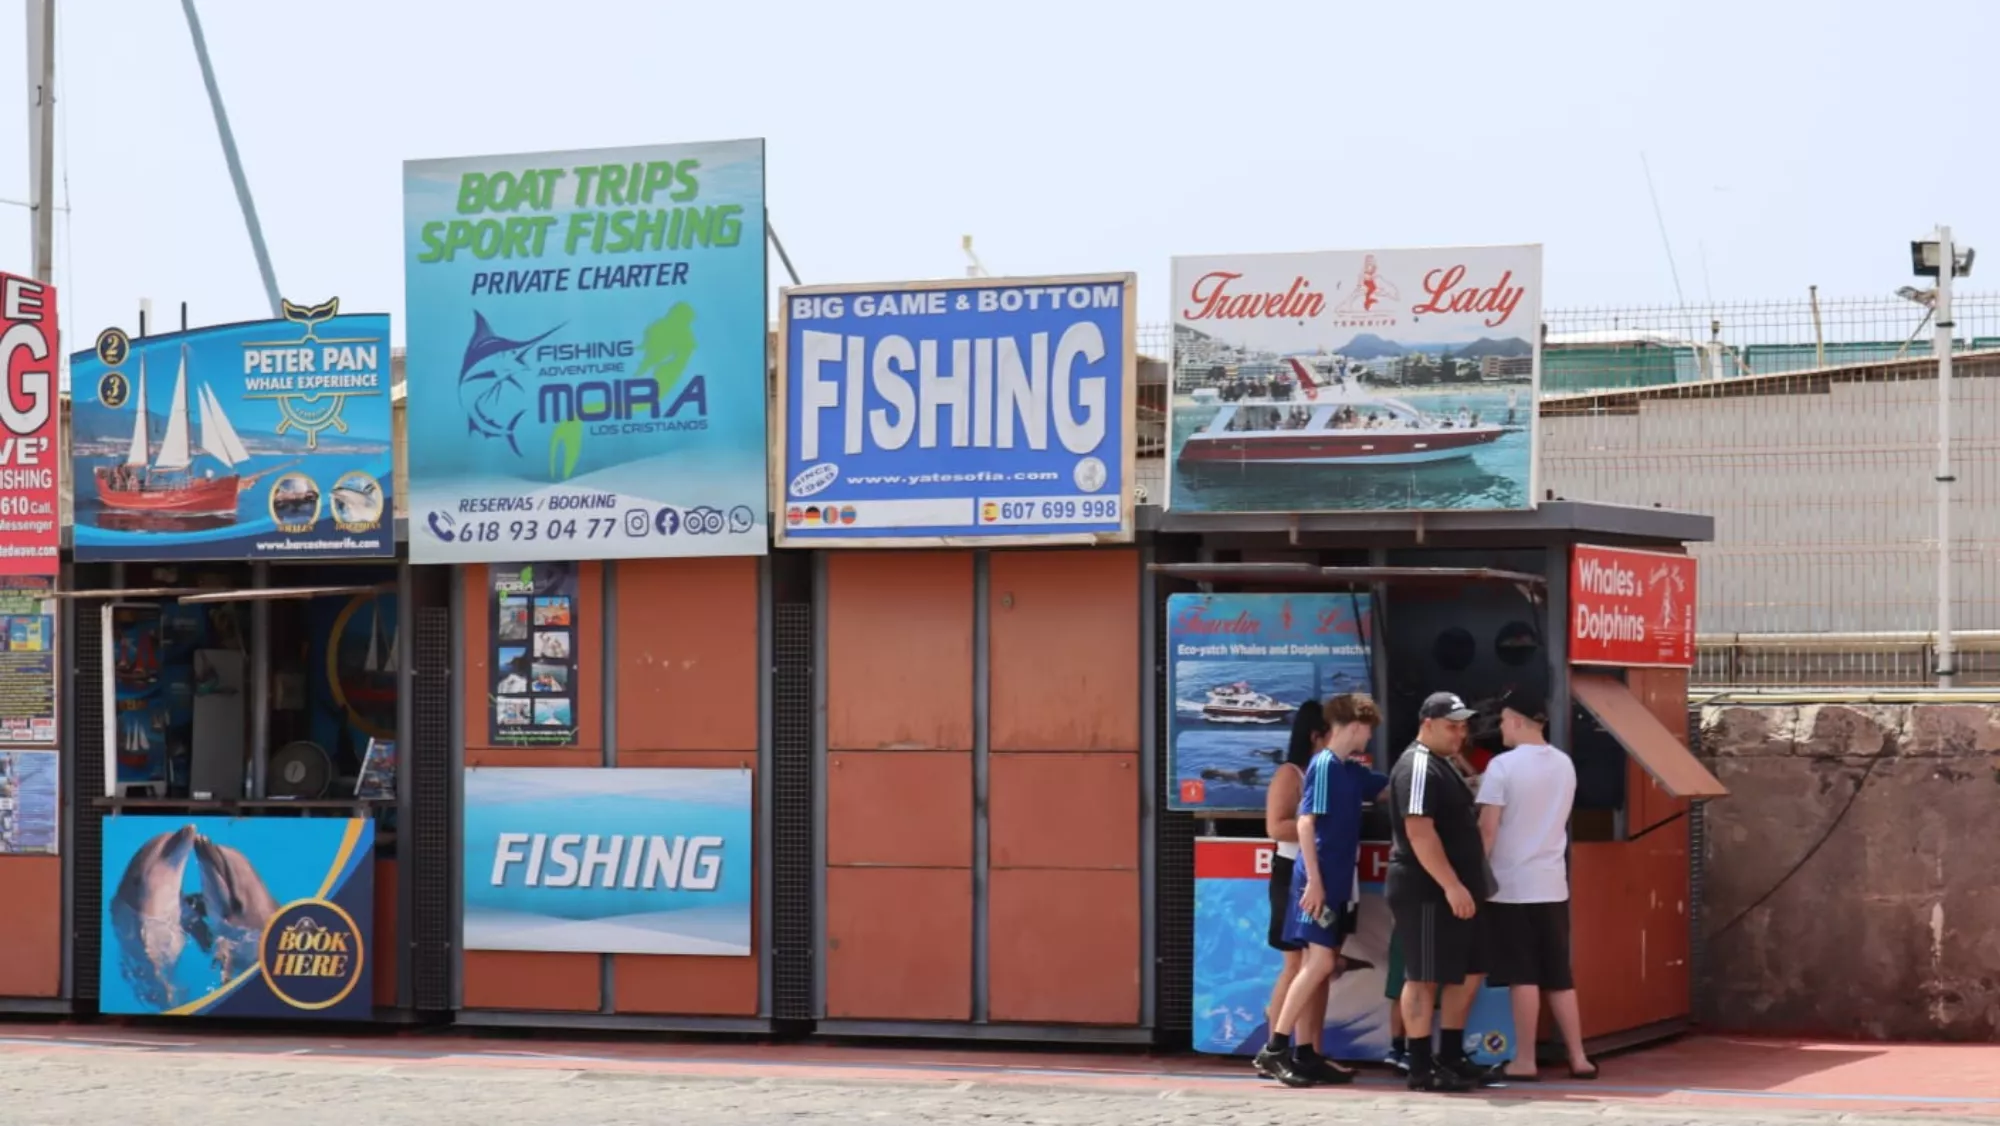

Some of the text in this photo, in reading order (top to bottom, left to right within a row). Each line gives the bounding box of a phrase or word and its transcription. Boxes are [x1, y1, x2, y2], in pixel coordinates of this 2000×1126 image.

[456, 159, 701, 214] BOAT TRIPS
[417, 204, 744, 262] SPORT FISHING
[471, 262, 689, 295] PRIVATE CHARTER
[5, 278, 43, 320] E
[792, 286, 1119, 320] BIG GAME & BOTTOM
[1184, 264, 1525, 327] Travelin Lady
[105, 335, 120, 355] 2
[537, 340, 634, 362] FISHING
[244, 346, 377, 374] PETER PAN
[537, 363, 625, 378] ADVENTURE
[0, 322, 50, 433] G
[107, 376, 120, 397] 3
[245, 374, 378, 391] WHALE EXPERIENCE
[801, 321, 1106, 461] FISHING
[538, 375, 707, 424] MOIRA
[590, 419, 708, 436] LOS CRISTIANOS
[846, 470, 1058, 486] www.yatesofia.com
[459, 498, 534, 514] RESERVAS
[549, 494, 617, 510] BOOKING
[1001, 500, 1117, 520] 607 699 998
[460, 517, 617, 543] 618 93 04 77
[1578, 557, 1635, 597] Whales
[1577, 603, 1645, 648] Dolphins
[1230, 644, 1267, 656] Whales
[1269, 644, 1288, 655] and
[1290, 644, 1330, 657] Dolphin
[491, 832, 722, 889] FISHING
[278, 930, 351, 952] BOOK
[273, 953, 348, 977] HERE
